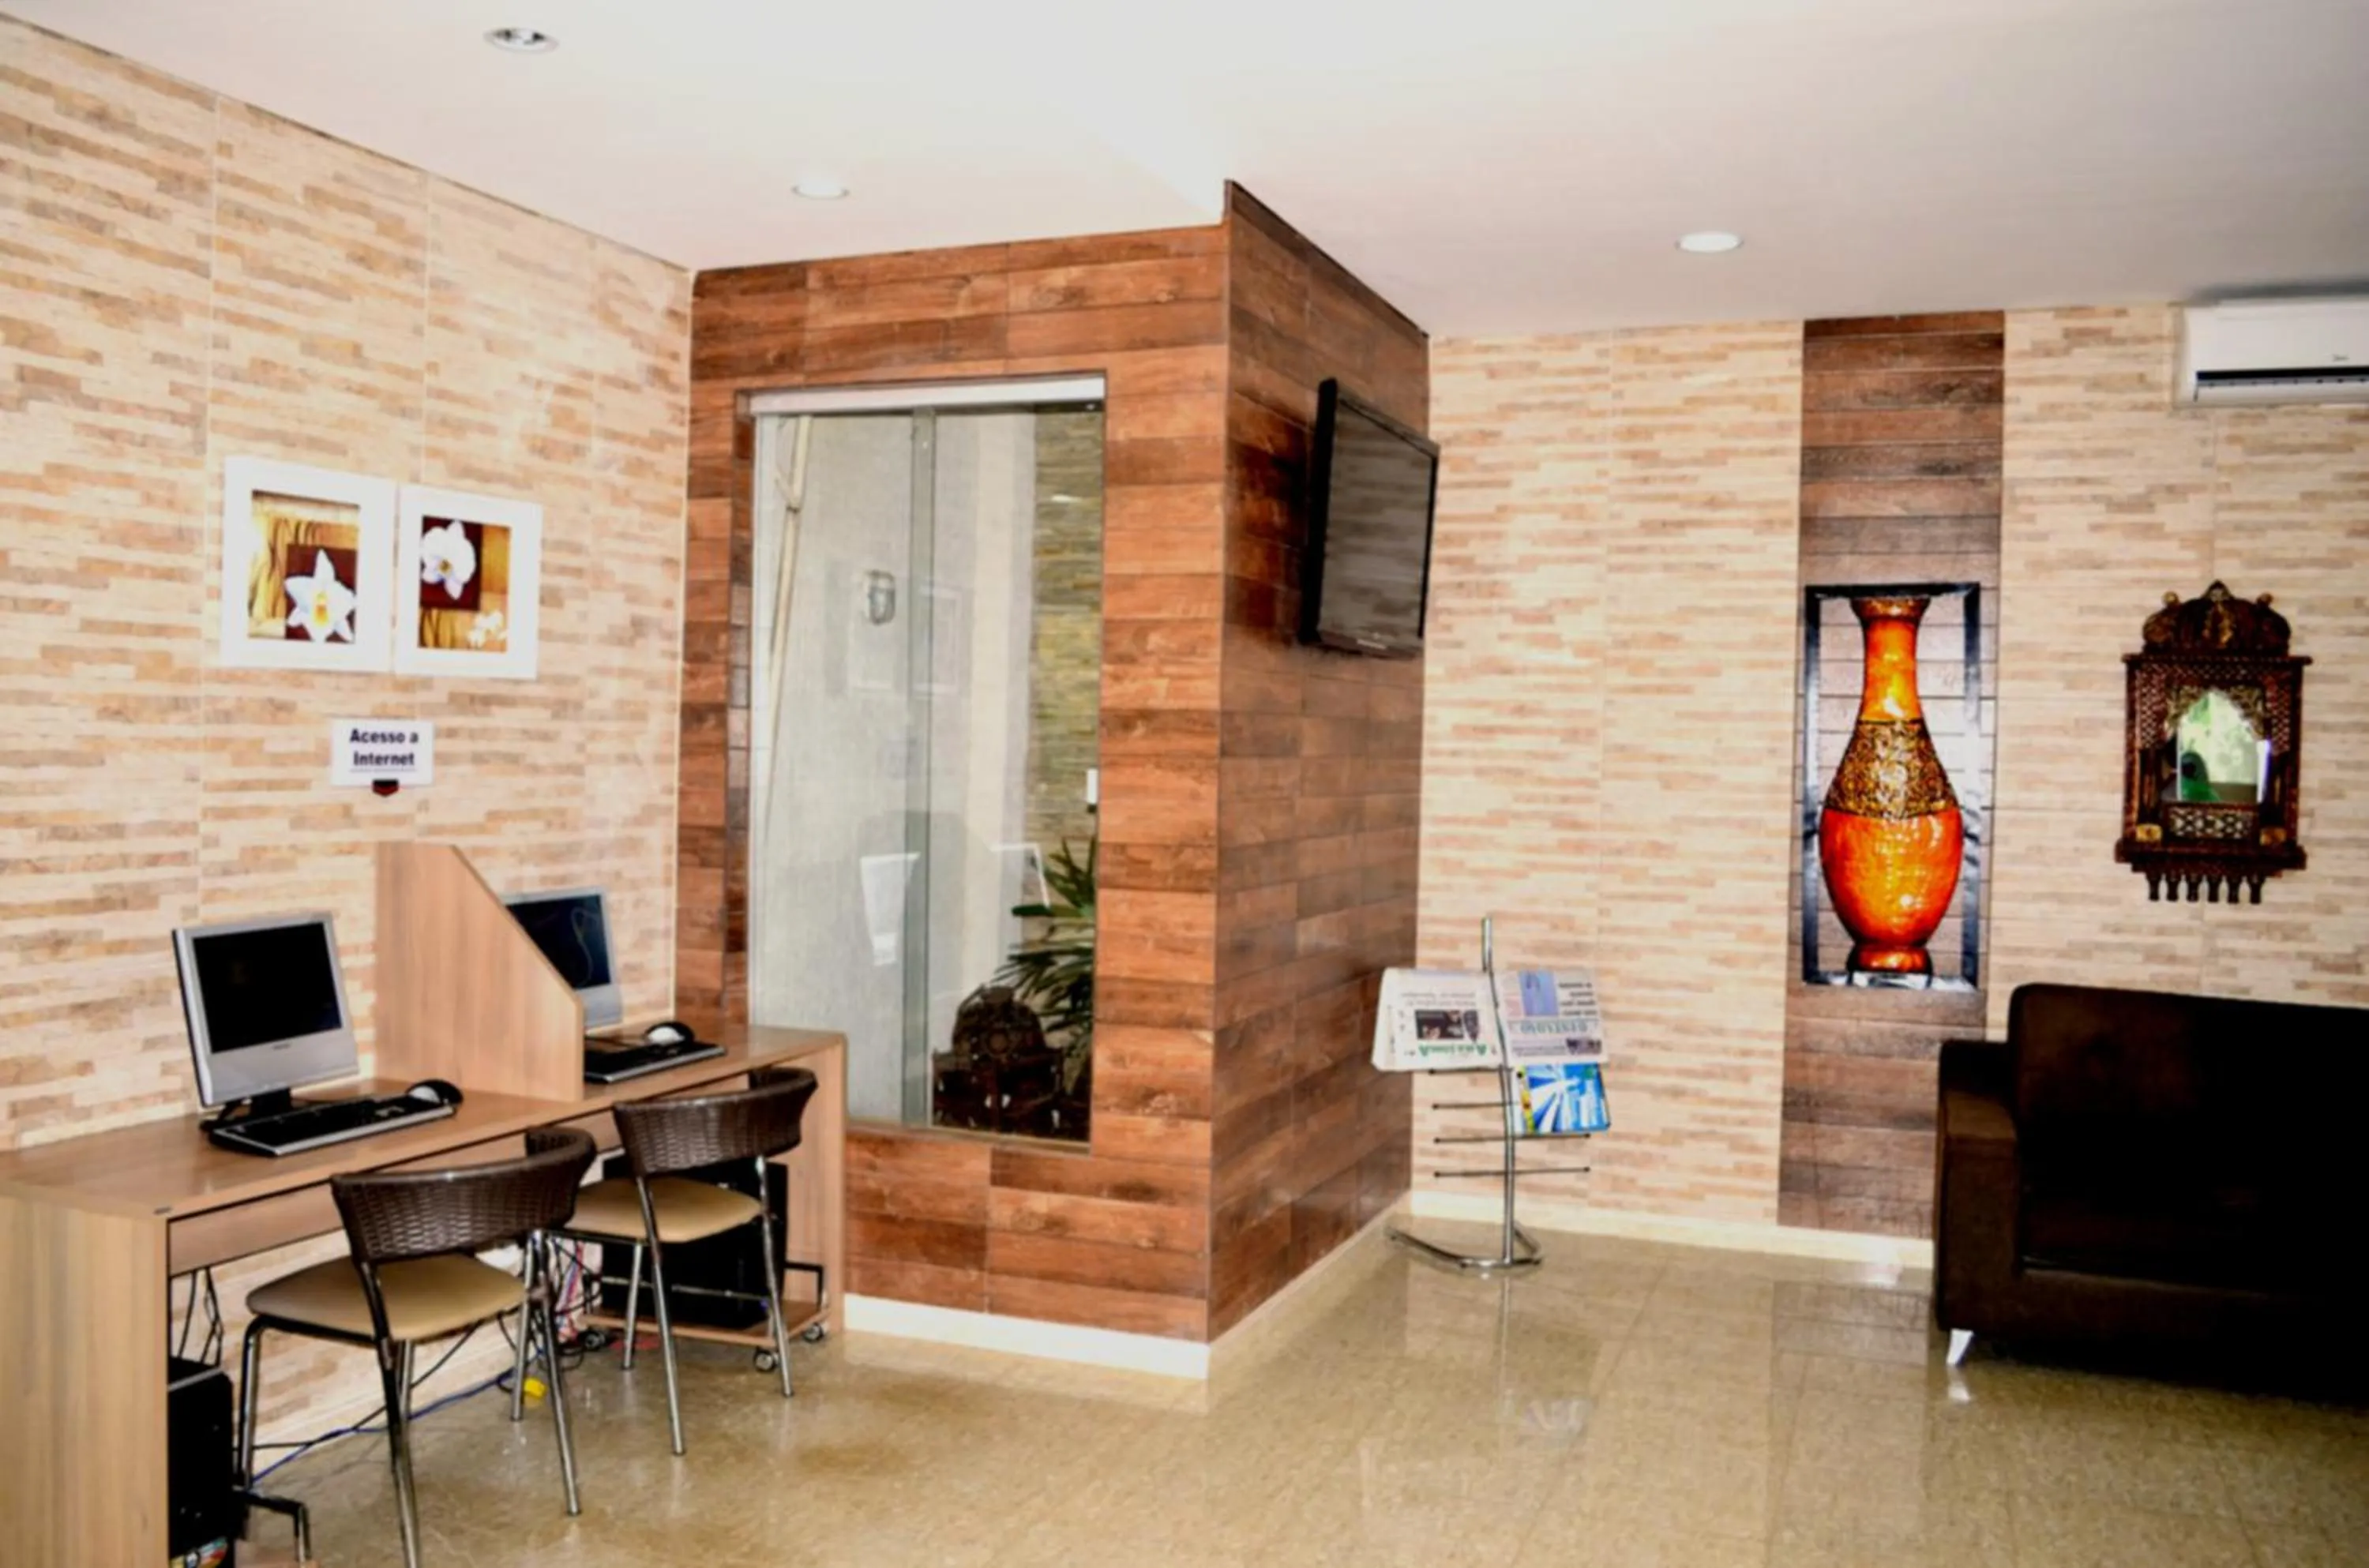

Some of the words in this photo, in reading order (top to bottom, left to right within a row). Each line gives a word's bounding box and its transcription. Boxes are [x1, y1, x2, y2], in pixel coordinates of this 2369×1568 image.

[350, 728, 405, 744] Acesso
[409, 732, 419, 744] a
[353, 751, 415, 766] Internet
